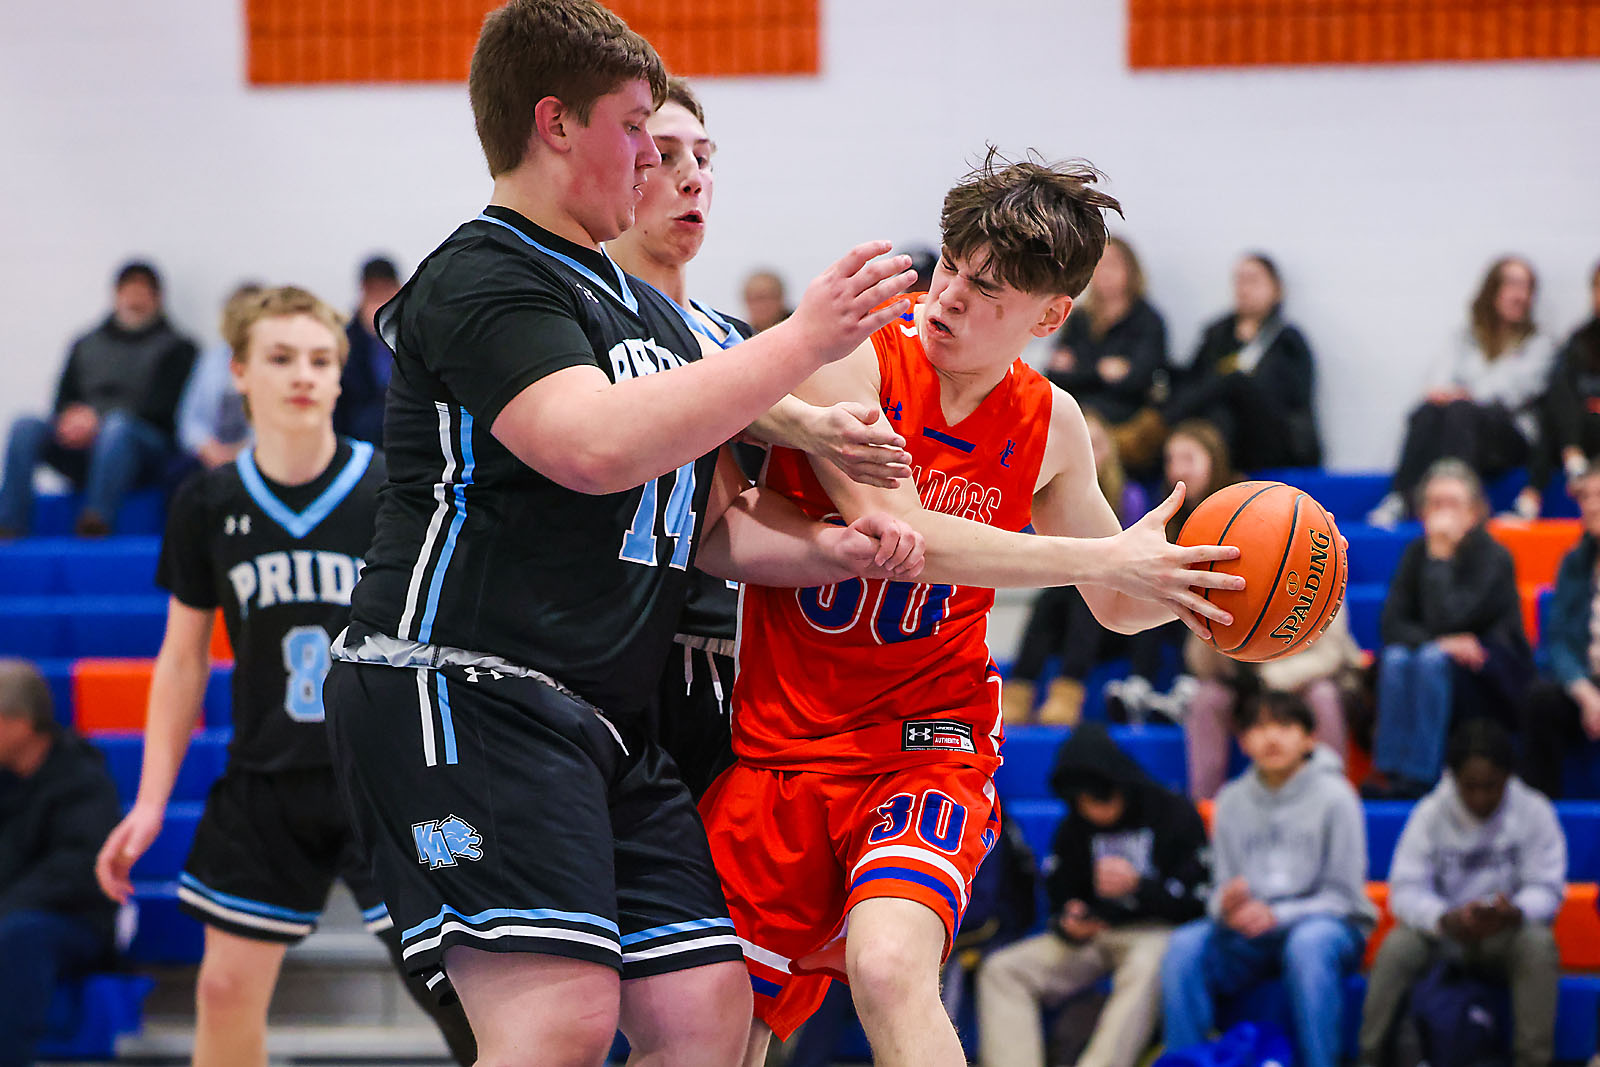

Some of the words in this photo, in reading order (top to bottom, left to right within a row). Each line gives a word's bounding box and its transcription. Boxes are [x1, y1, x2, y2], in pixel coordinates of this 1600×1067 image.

[608, 337, 690, 383] PRID
[227, 550, 366, 619] PRID
[1269, 528, 1331, 644] SPALDING
[281, 624, 333, 723] 8
[934, 736, 960, 745] AUTHENTIC
[411, 820, 458, 871] KA
[868, 788, 969, 856] 30
